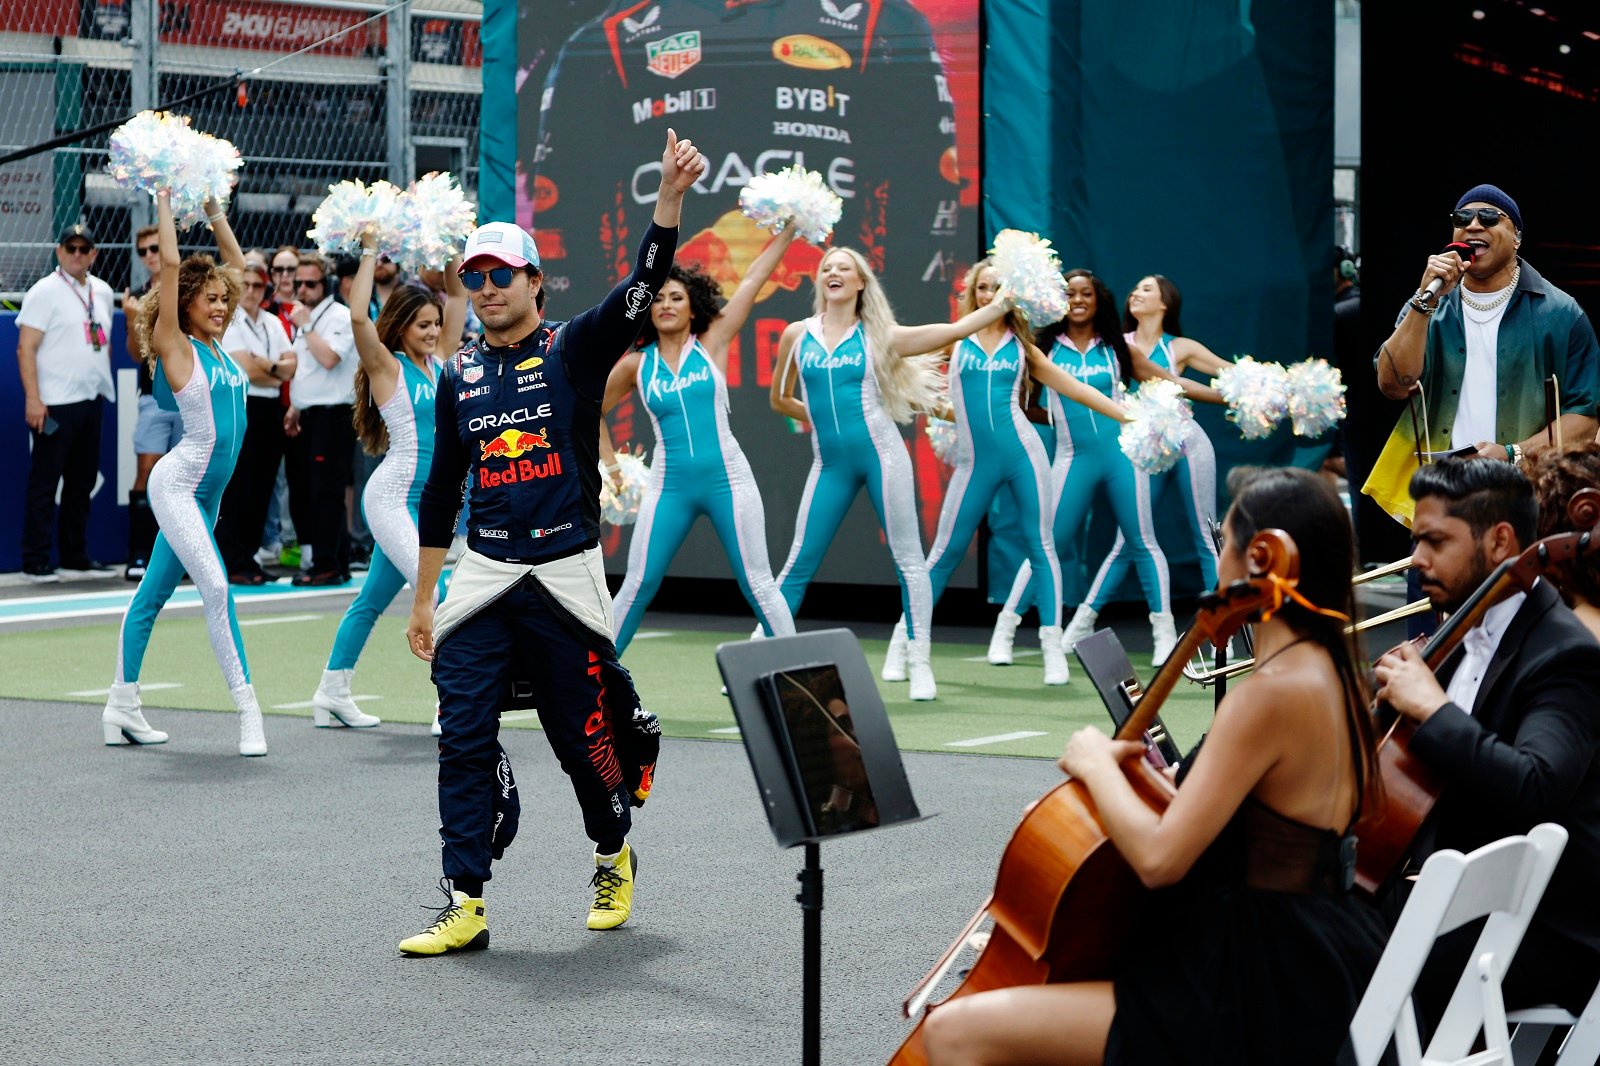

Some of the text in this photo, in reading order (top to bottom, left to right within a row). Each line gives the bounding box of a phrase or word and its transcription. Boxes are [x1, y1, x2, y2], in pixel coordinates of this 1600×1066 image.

[648, 34, 697, 57] TAG
[632, 90, 692, 124] Mobil
[776, 85, 850, 117] BYBIT
[772, 121, 852, 144] HONDA
[625, 281, 650, 320] Hard Rock
[517, 371, 543, 385] BYBIT
[517, 382, 548, 393] HONDA
[458, 387, 481, 402] Mobil
[468, 403, 553, 432] ORACLE
[480, 460, 518, 489] Red
[518, 452, 562, 482] Bull
[479, 528, 509, 540] sparco
